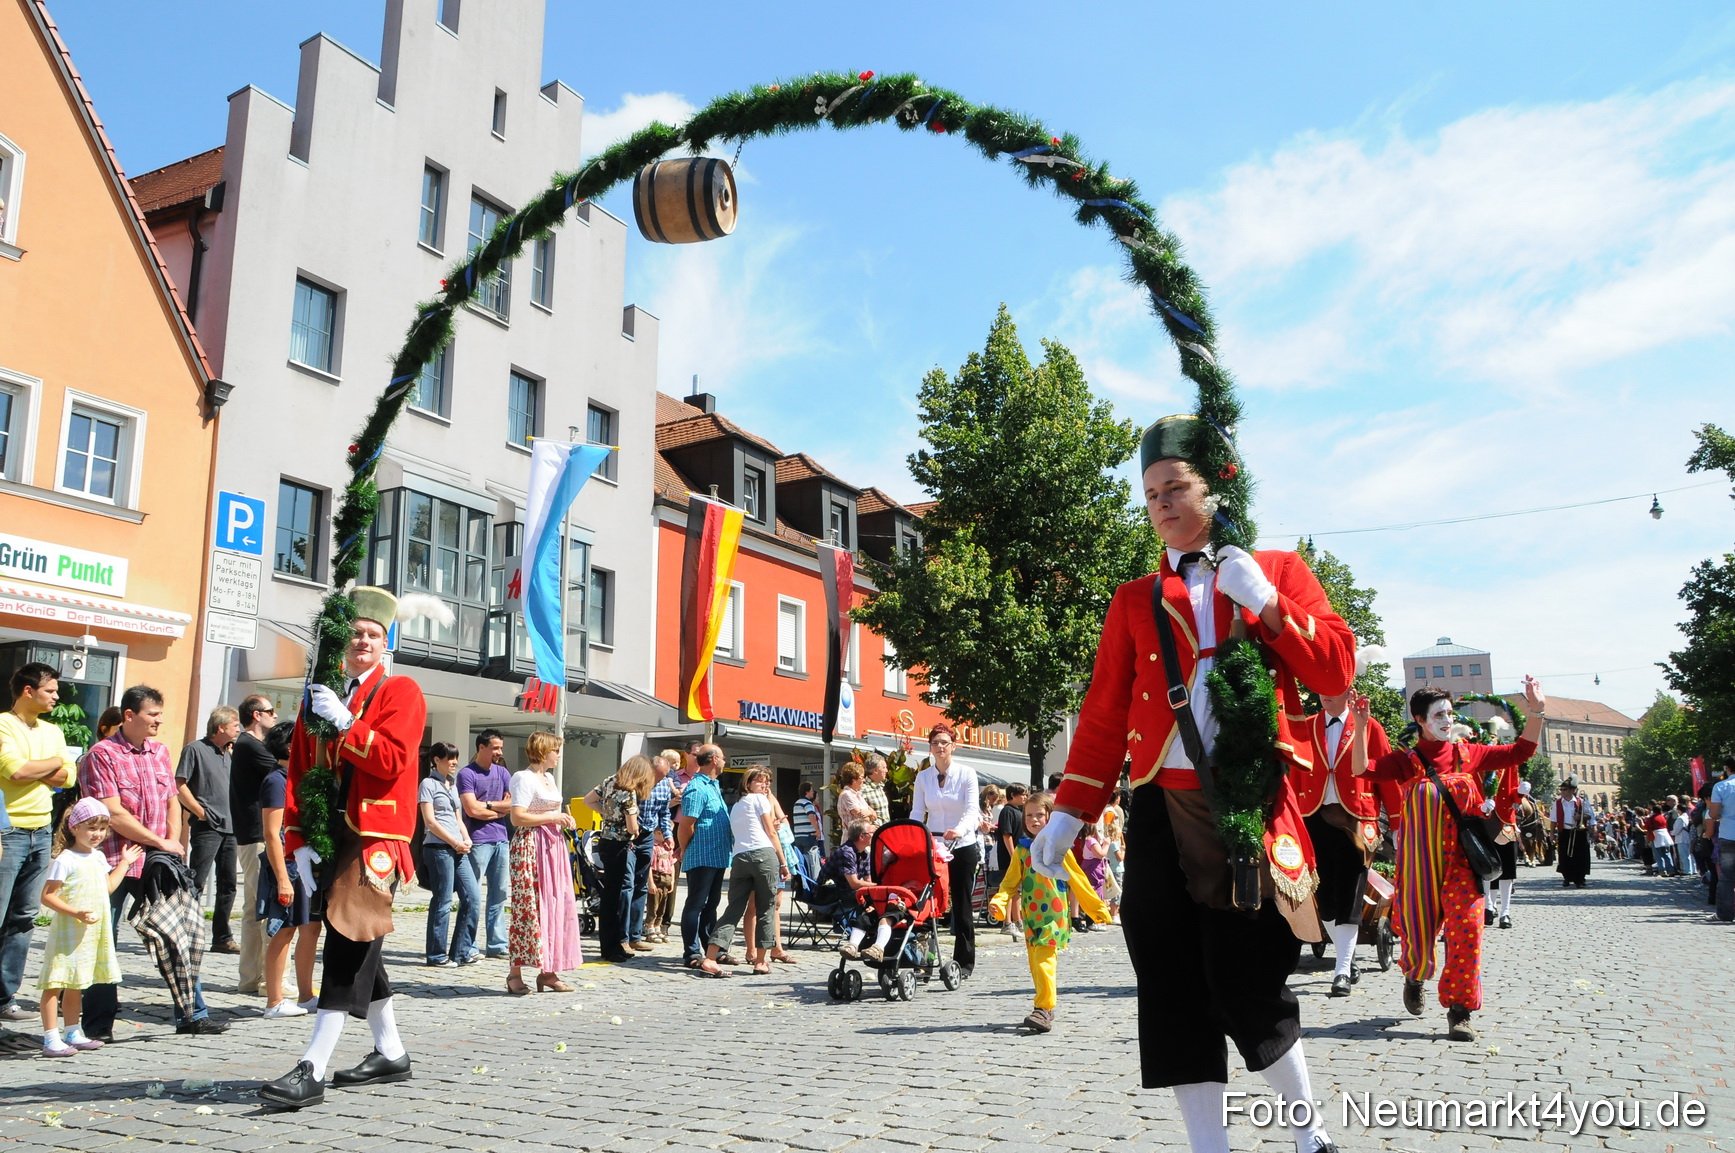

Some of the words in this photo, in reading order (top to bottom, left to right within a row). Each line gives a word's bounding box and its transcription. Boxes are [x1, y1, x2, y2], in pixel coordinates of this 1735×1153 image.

[227, 500, 254, 543] P
[0, 543, 48, 573] Grün
[57, 554, 114, 587] Punkt
[223, 558, 236, 566] nur
[240, 561, 252, 569] mit
[216, 564, 258, 580] Parkschein
[219, 576, 254, 590] werktags
[212, 595, 221, 604] Sa
[67, 610, 91, 623] Der
[93, 614, 139, 631] Blumen
[732, 758, 745, 766] NZ
